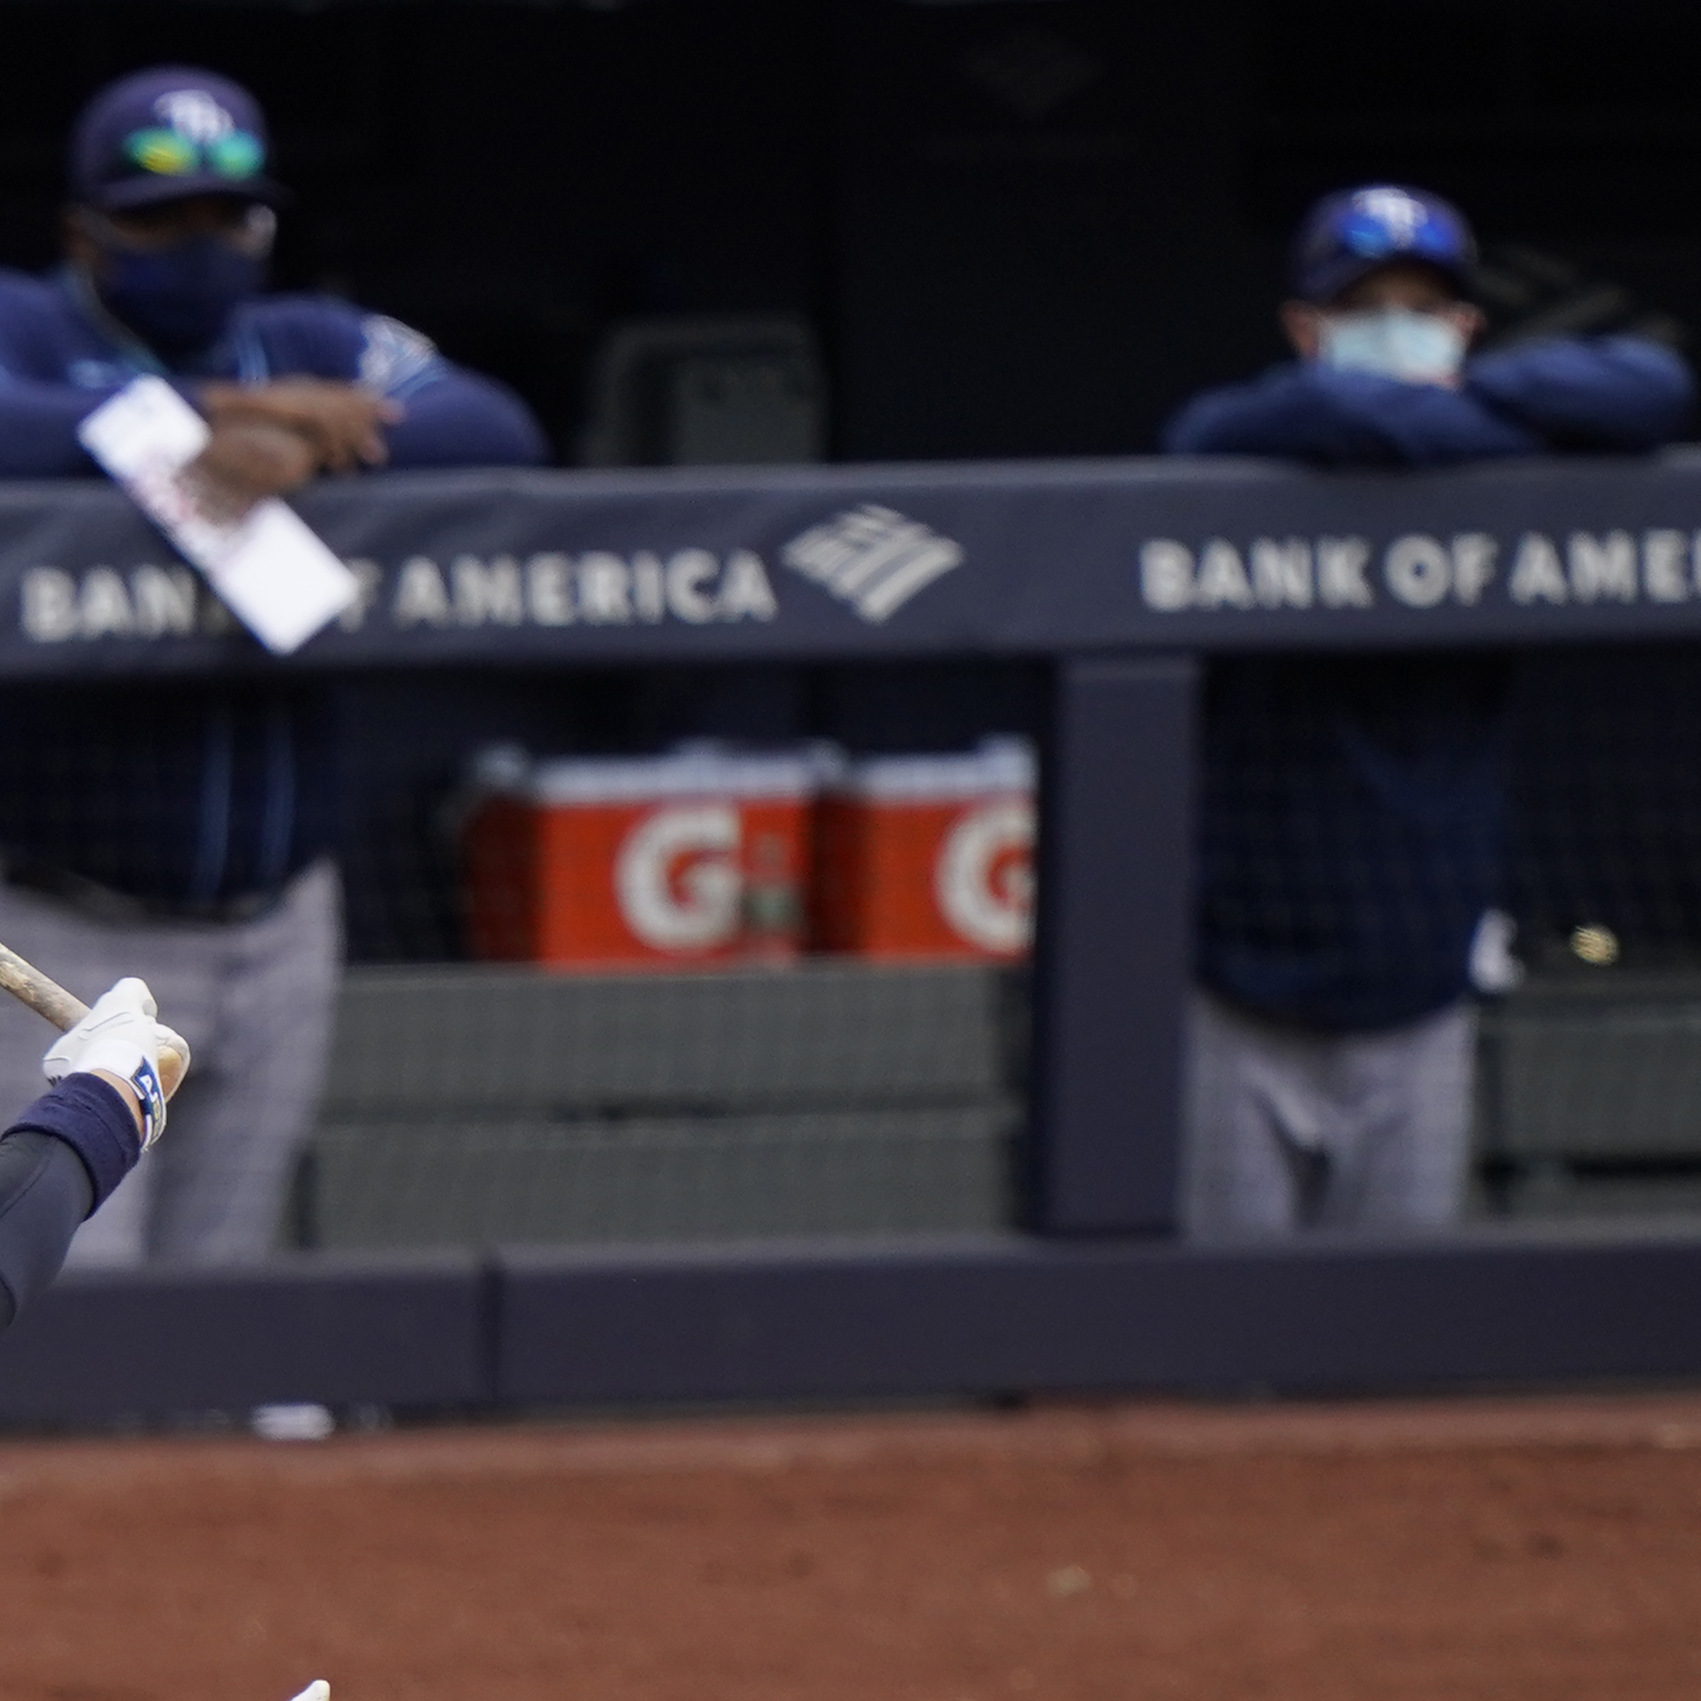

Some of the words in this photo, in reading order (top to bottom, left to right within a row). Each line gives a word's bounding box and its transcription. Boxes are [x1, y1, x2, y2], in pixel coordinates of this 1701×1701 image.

[396, 549, 777, 627] AMERICA
[1139, 535, 1373, 611] BANK
[1385, 532, 1497, 608] OF
[1509, 527, 1701, 605] AME
[613, 803, 742, 954] G
